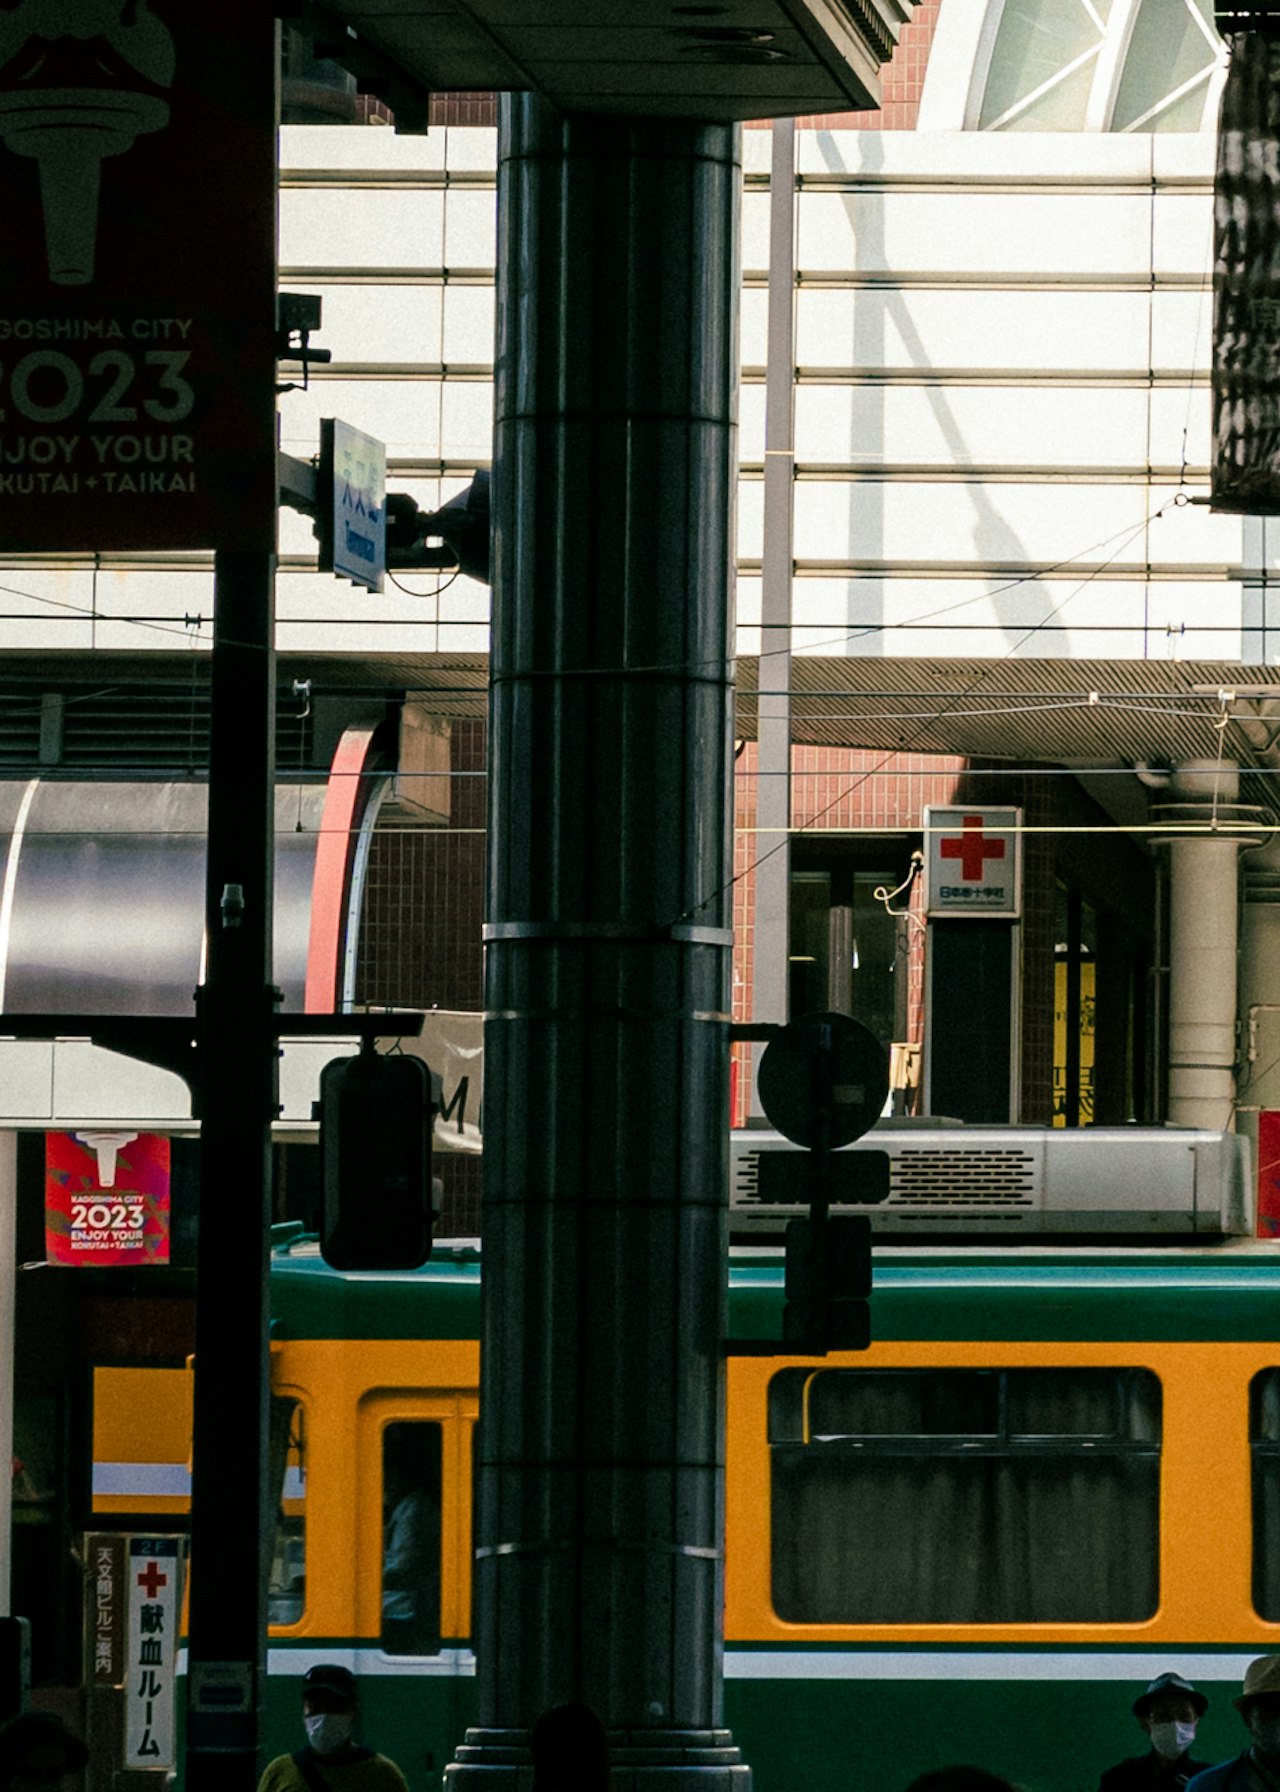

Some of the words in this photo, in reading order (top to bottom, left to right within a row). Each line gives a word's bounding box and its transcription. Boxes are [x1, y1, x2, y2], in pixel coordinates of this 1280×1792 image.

[131, 319, 193, 340] CITY
[0, 349, 195, 423] 023
[0, 435, 80, 464] JOY
[90, 435, 195, 464] YOUR
[71, 1205, 144, 1228] 2023
[71, 1230, 109, 1240] ENJOY
[112, 1230, 143, 1240] YOUR
[141, 1543, 166, 1555] 2F
[138, 1605, 163, 1757] 献血ルーム
